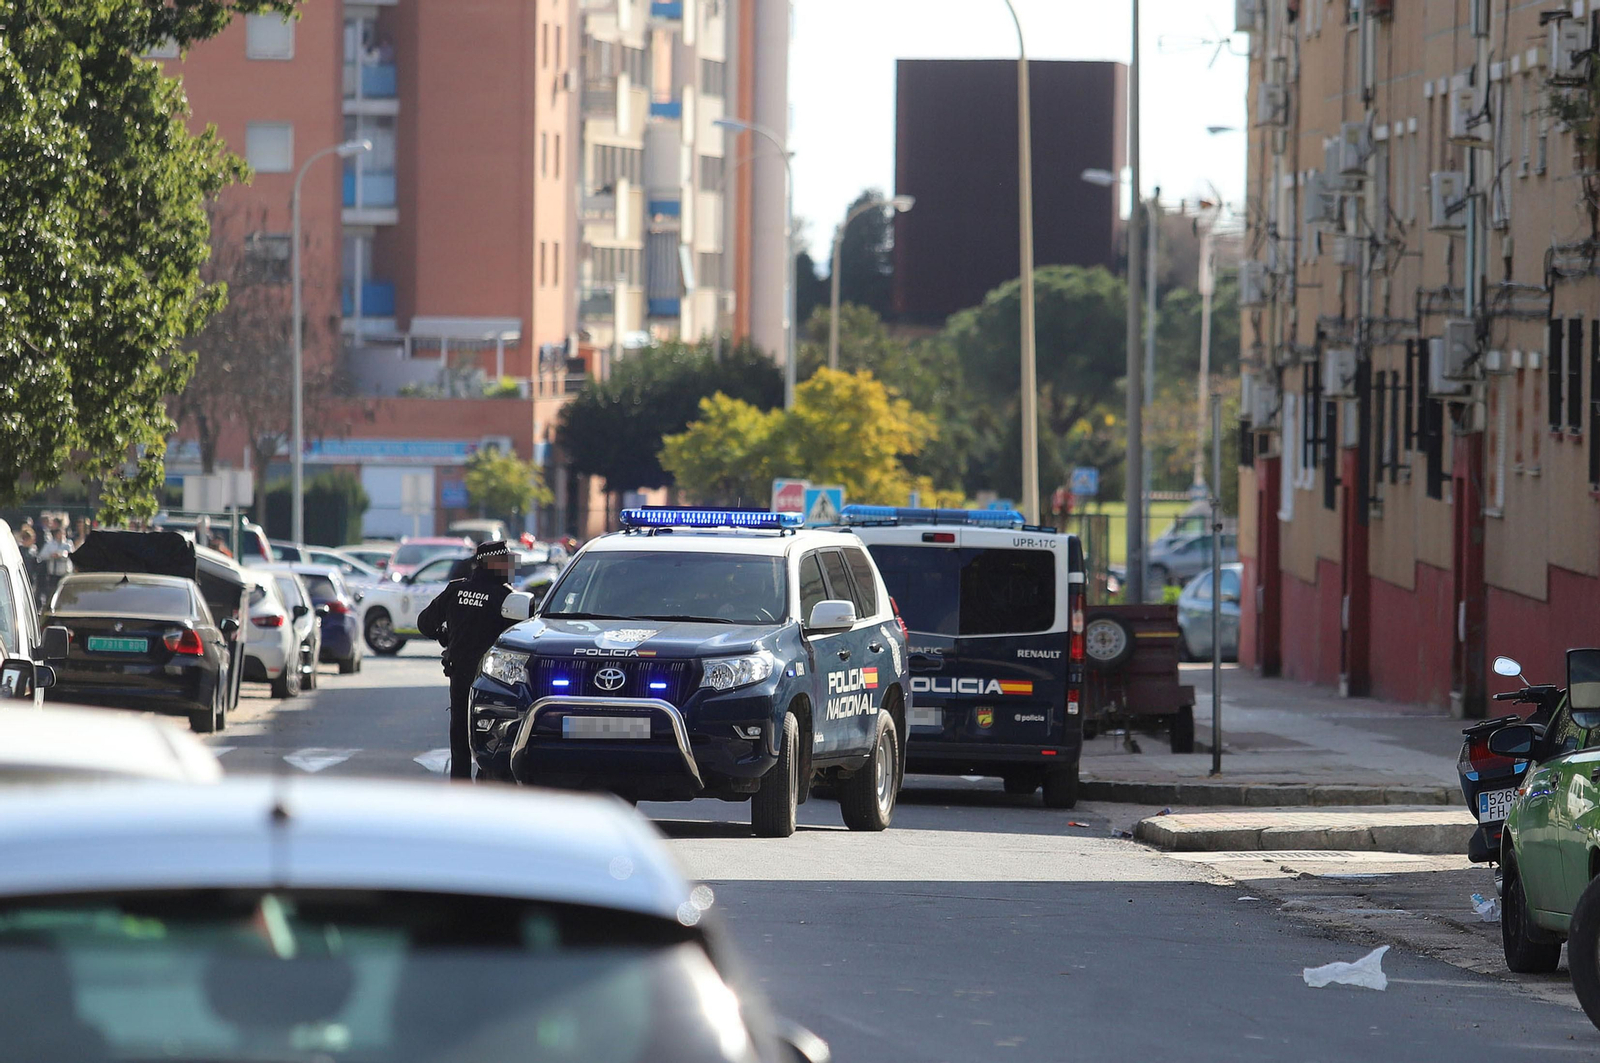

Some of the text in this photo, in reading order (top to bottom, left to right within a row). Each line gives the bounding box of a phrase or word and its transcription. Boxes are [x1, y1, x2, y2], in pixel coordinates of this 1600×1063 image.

[777, 495, 803, 508] STO
[1013, 538, 1056, 549] UPR-17C
[457, 590, 489, 601] POLICIA
[459, 597, 483, 607] LOCAL
[573, 648, 639, 657] POLICIA
[907, 646, 942, 655] RAFIC
[1017, 649, 1061, 659] RENAULT
[828, 667, 867, 695] POLICIA
[909, 676, 1003, 695] OLICIA
[826, 693, 878, 721] NACIONAL
[1014, 713, 1045, 722] @policia
